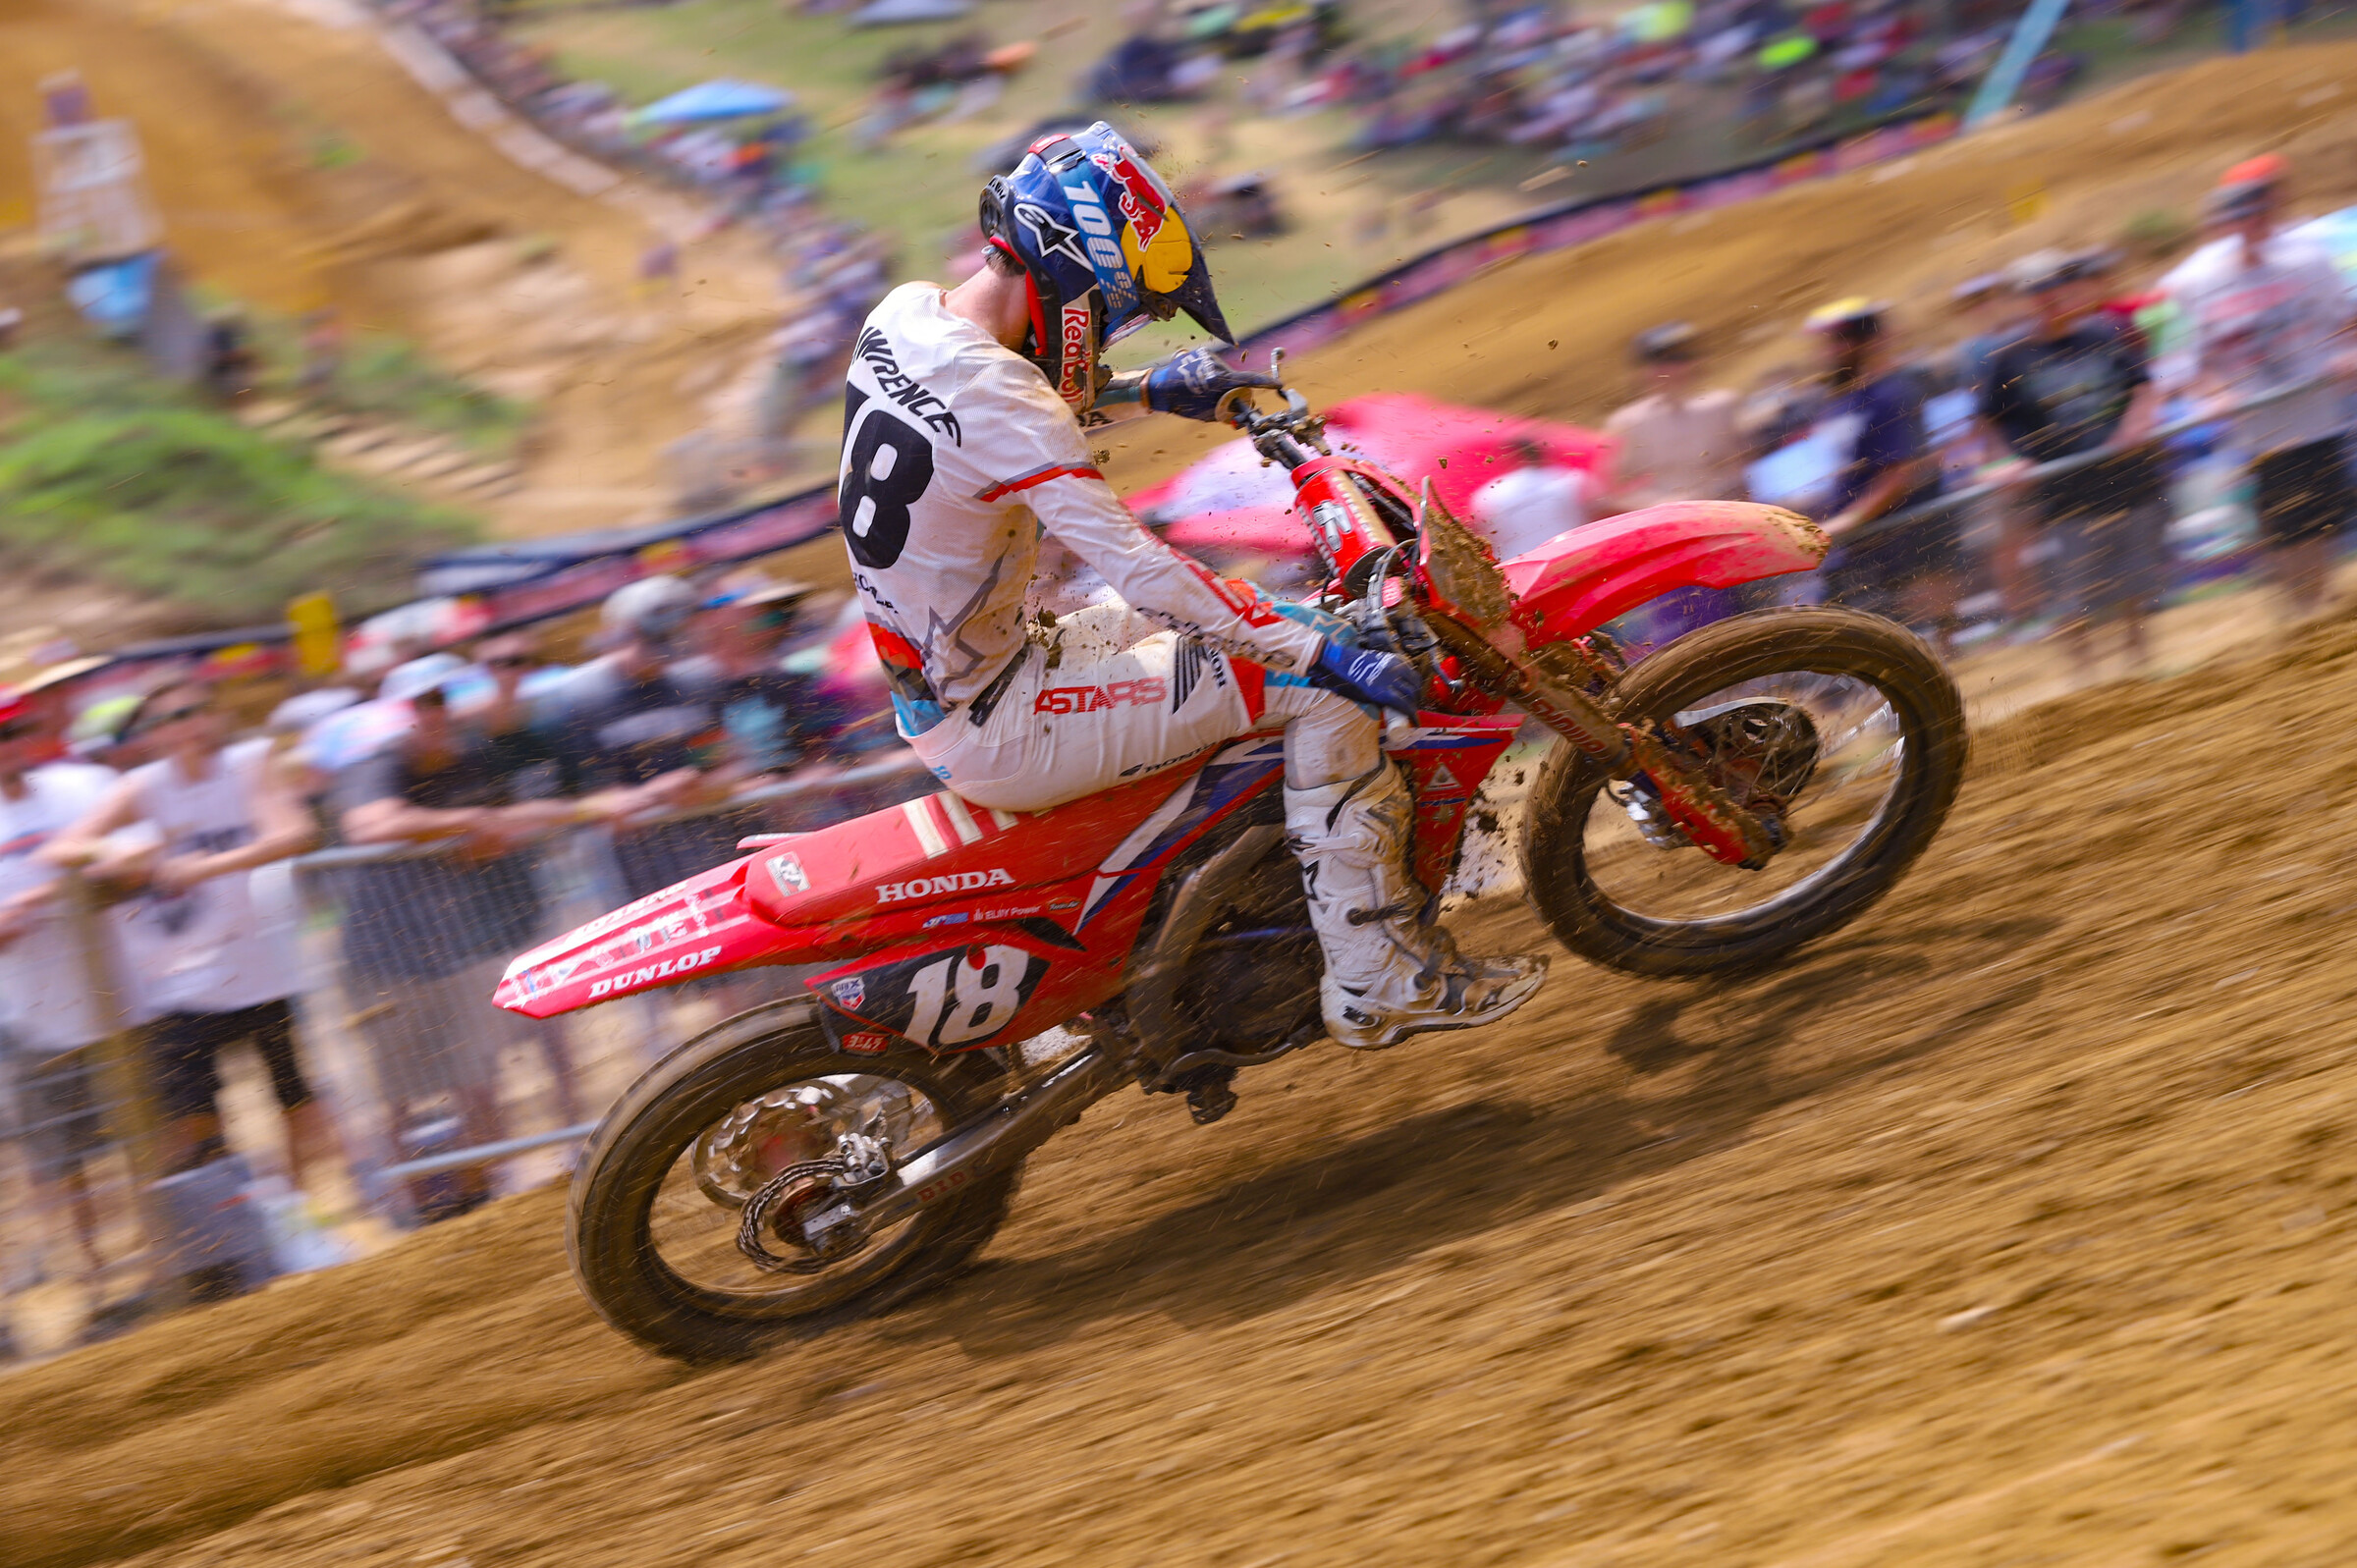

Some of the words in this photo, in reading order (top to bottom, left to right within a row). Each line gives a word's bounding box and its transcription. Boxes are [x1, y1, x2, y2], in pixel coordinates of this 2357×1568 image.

[875, 868, 1016, 904] HONDA
[588, 946, 722, 999] DUNLOP
[904, 944, 1030, 1049] 18
